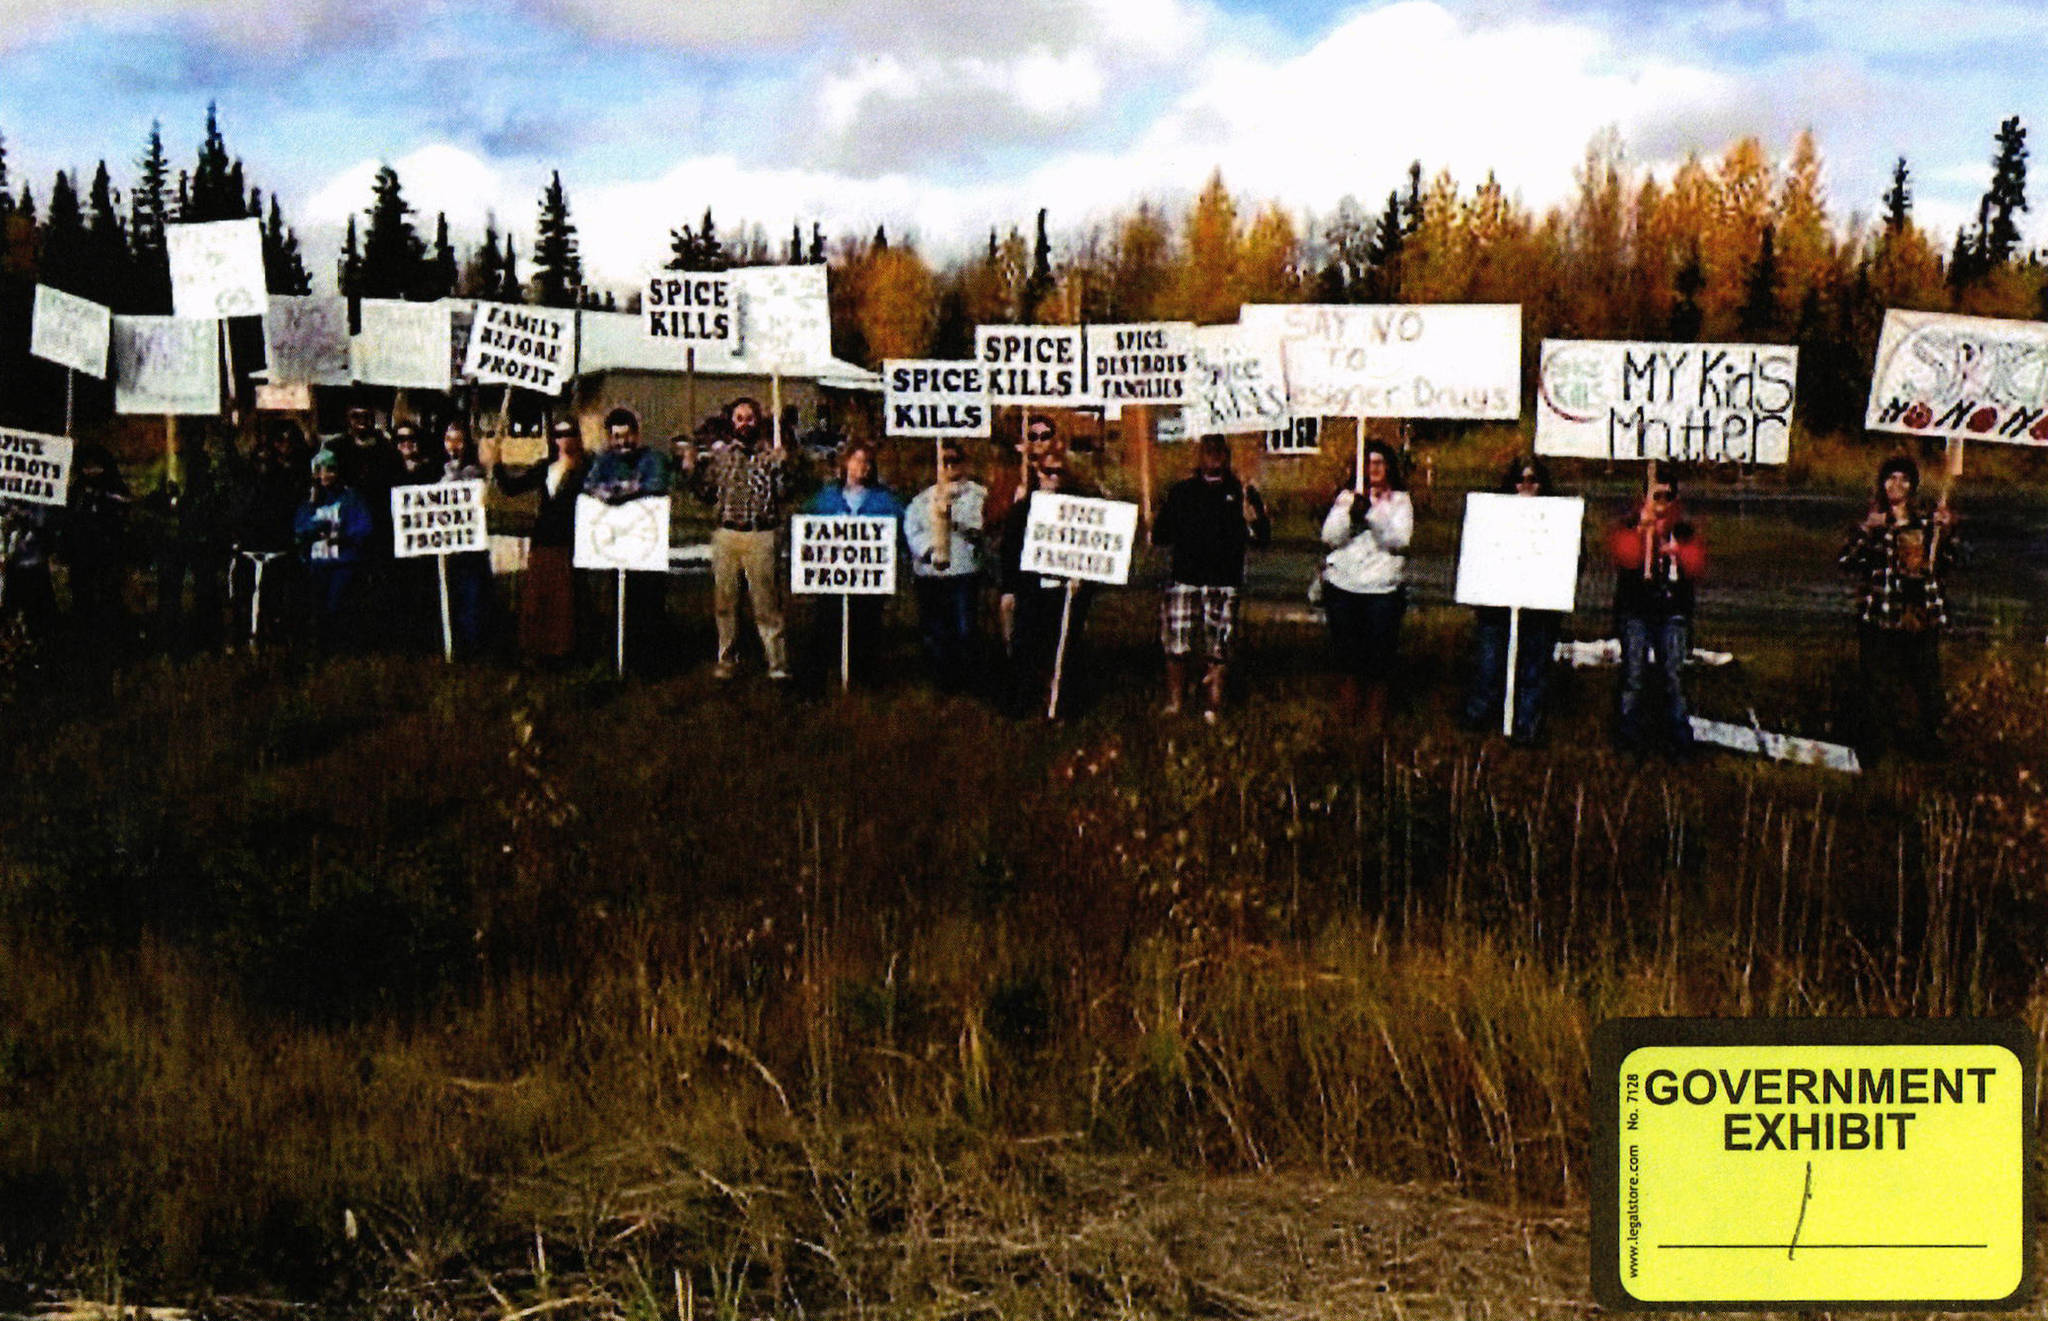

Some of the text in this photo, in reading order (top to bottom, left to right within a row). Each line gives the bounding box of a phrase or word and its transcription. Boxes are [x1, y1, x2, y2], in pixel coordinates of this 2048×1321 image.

[650, 279, 729, 307] SPICE
[488, 307, 562, 339] FAMILY
[650, 311, 729, 340] KILLS
[1371, 310, 1424, 344] NO
[983, 336, 1073, 363] SPICE
[1116, 330, 1168, 350] SPICE
[478, 352, 555, 386] PROFIT
[892, 368, 982, 393] SPICE
[988, 368, 1072, 396] KILLS
[1623, 350, 1688, 402] MY
[895, 404, 982, 429] KILLS
[804, 521, 884, 541] FAMILY
[801, 544, 889, 565] BEFORE
[804, 567, 884, 587] PROFIT
